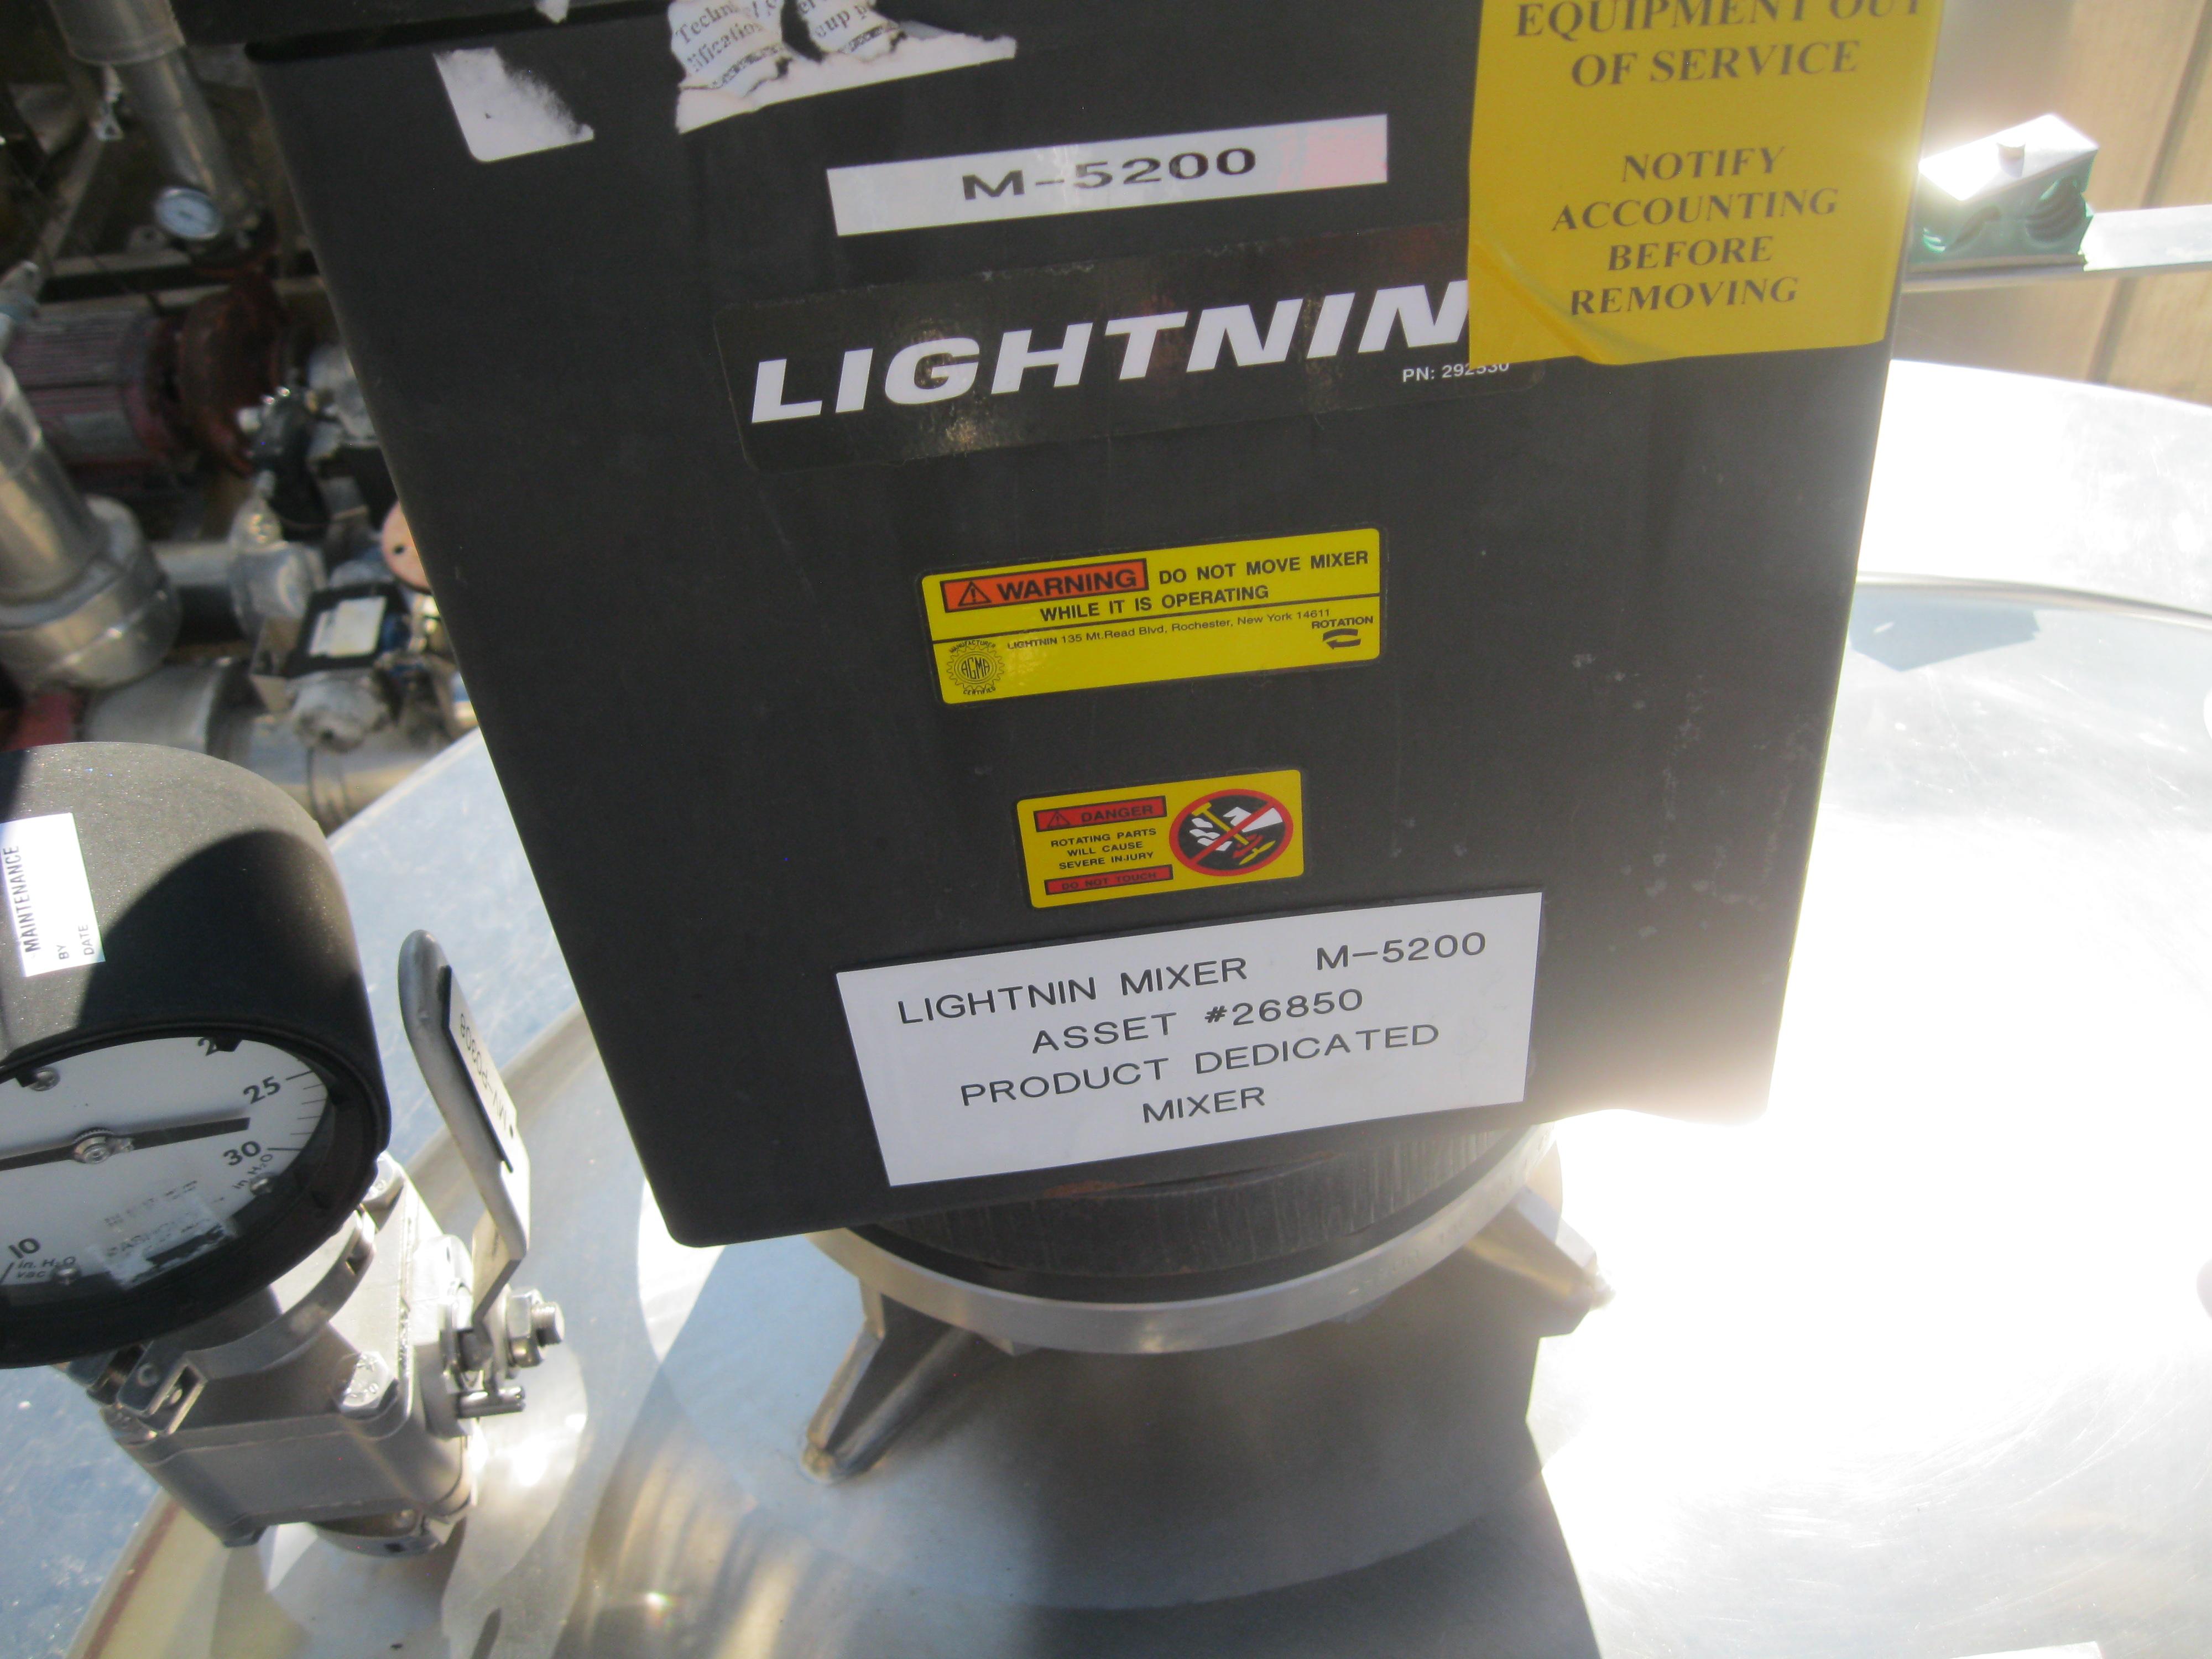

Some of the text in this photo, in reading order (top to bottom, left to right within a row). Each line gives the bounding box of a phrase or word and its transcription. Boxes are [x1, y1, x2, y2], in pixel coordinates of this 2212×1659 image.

[1515, 0, 1807, 41] EQUIPMENT
[1572, 40, 1860, 87] OF SERVICE
[962, 148, 1256, 200] M-5200
[1621, 146, 1785, 183] NOTIFY
[1552, 188, 1838, 231] ACCOUNTING
[1608, 236, 1773, 272] BEFORE
[1571, 276, 1799, 315] REMOVING
[752, 280, 1469, 424] LIGHTNIN
[1402, 367, 1435, 382] PN:
[997, 550, 1369, 601] WARNING DO NOT MOVE MIXER
[1040, 585, 1269, 622] WHILE IT IS OPERATING
[1008, 637, 1057, 650] LIGHTNIN
[1062, 634, 1082, 644] 135
[1139, 625, 1167, 635] Blvd,
[1172, 619, 1233, 632] Rochester,
[1238, 615, 1262, 625] New
[1267, 613, 1292, 622] York
[1297, 609, 1330, 619] 14611
[1311, 615, 1374, 629] ROTATION
[949, 640, 996, 653] MANUFACTURER
[961, 656, 990, 679] AGMA
[963, 686, 996, 696] CERTIFIED
[1081, 804, 1154, 823] DANGER
[1051, 828, 1156, 847] ROTATING PARTS
[1067, 841, 1143, 857] WILL CAUSE
[1058, 851, 1154, 870] SEVERE INJURY
[3, 846, 40, 952] MAINTENANCE
[1062, 872, 1156, 891] DO NOT TOUCH
[56, 944, 69, 959] BY
[78, 924, 95, 956] DATE
[898, 931, 1487, 1024] LIGHTNIN MIXER M-5200
[1032, 988, 1364, 1054] ASSET #26850
[961, 1024, 1440, 1107] PRODUCT DEDICATED
[243, 1076, 281, 1104] 25
[1142, 1086, 1266, 1125] MIXER
[223, 1141, 261, 1166] 30
[8, 1238, 40, 1259] 10
